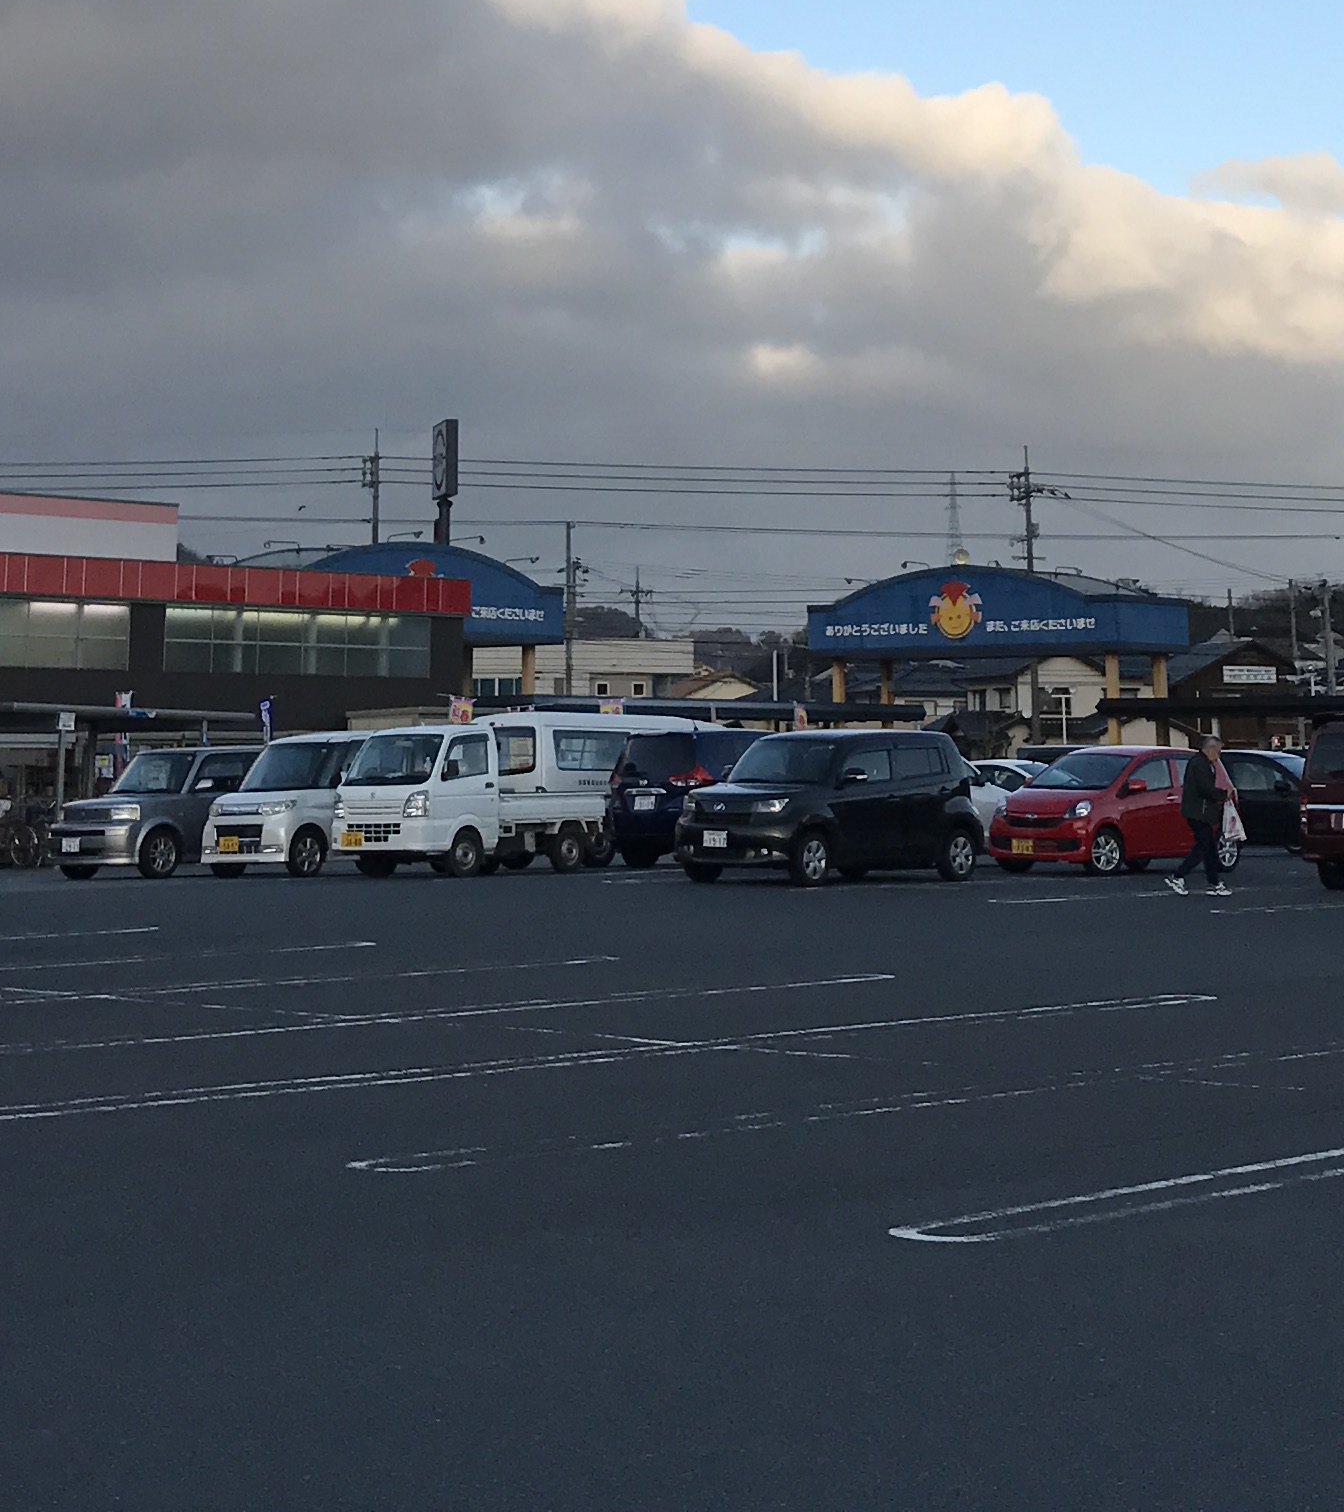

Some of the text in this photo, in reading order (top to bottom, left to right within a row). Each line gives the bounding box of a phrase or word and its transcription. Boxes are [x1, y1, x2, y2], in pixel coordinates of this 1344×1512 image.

[825, 622, 929, 637] ありがとうございました
